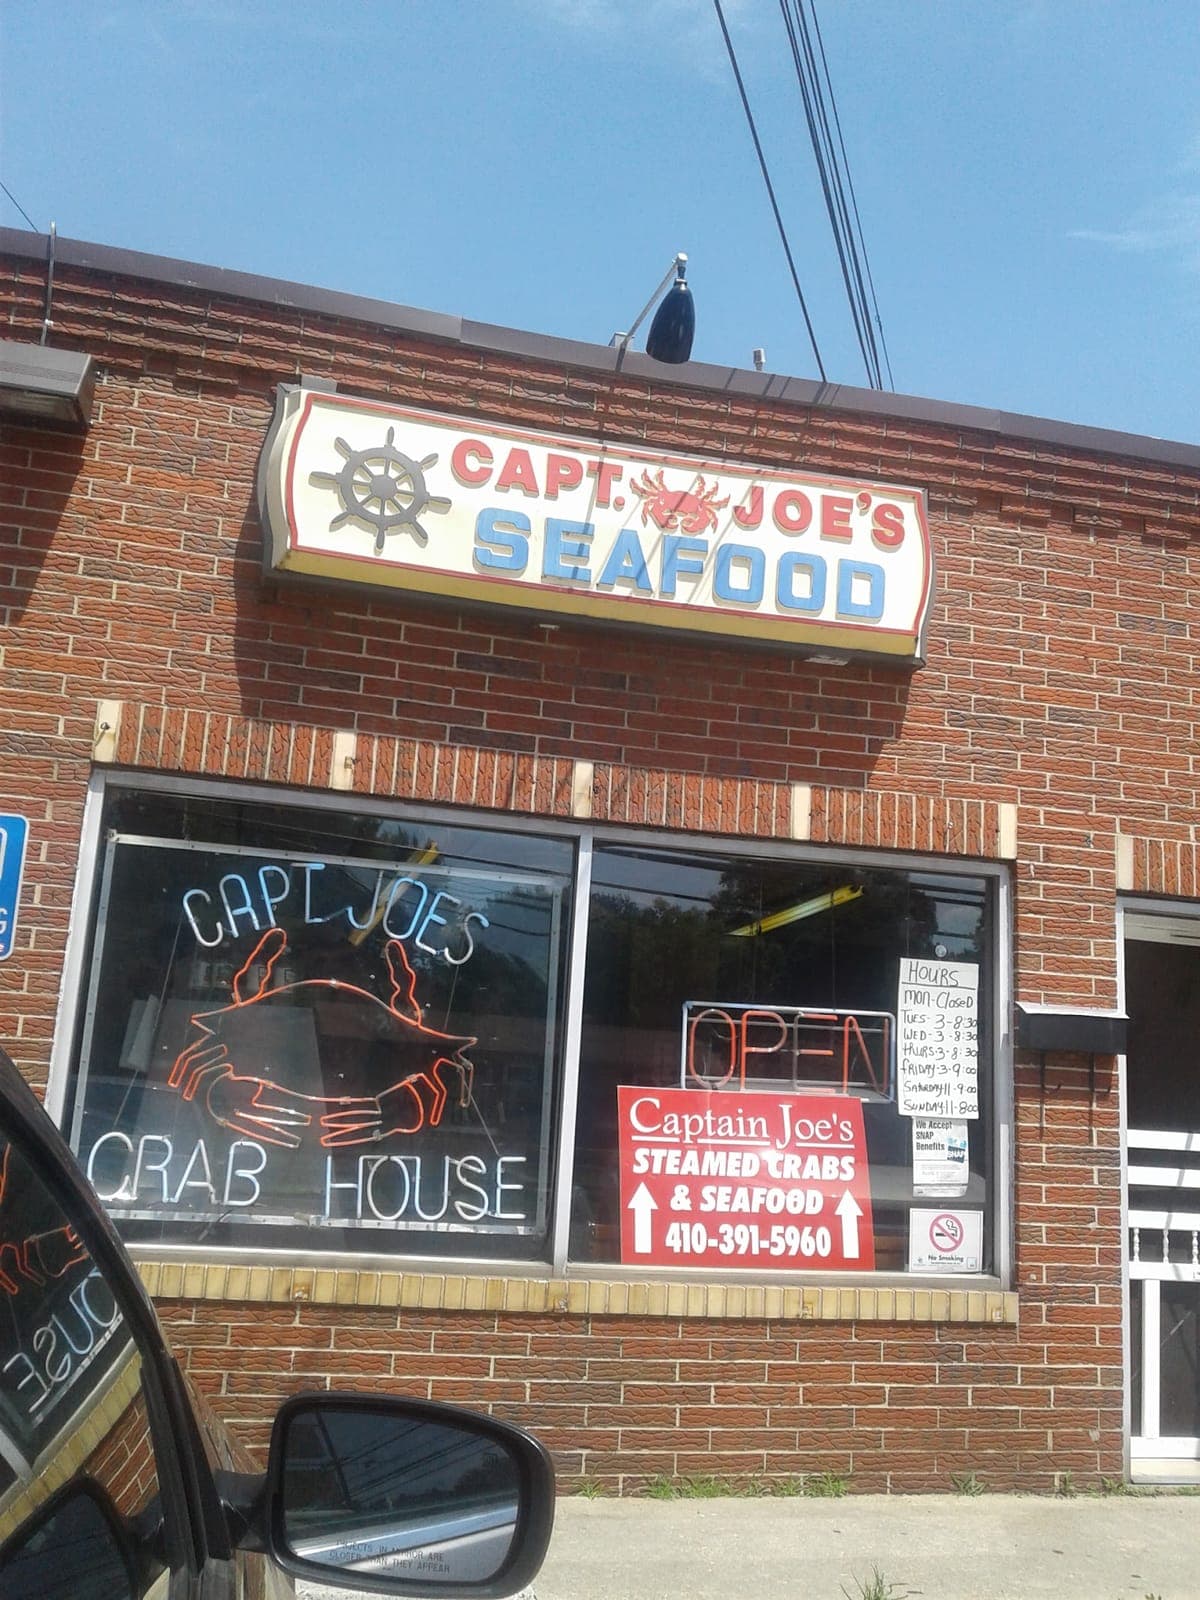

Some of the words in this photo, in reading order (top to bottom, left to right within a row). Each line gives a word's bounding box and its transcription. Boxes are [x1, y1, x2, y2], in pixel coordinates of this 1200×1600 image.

[451, 439, 626, 511] CAPT.
[732, 485, 905, 550] JOE'S
[473, 508, 886, 625] SEAFOOD
[183, 863, 325, 947] CAPT
[347, 870, 489, 965] JOES
[909, 961, 959, 986] HOURS
[689, 1008, 889, 1094] OPEN
[630, 1098, 770, 1145] Captain
[775, 1104, 854, 1149] Joe's
[916, 1120, 926, 1129] We
[928, 1120, 952, 1131] Accept
[916, 1131, 934, 1140] SNAP
[916, 1142, 945, 1151] Benefits
[87, 1131, 267, 1207] CRAB
[325, 1154, 527, 1221] HOUSE
[632, 1148, 761, 1178] STEAMED
[763, 1151, 855, 1181] CRABS
[670, 1185, 692, 1211] &
[700, 1186, 824, 1215] SEAFOOD
[665, 1222, 831, 1257] 410-391-5960
[939, 1254, 964, 1263] Smoking
